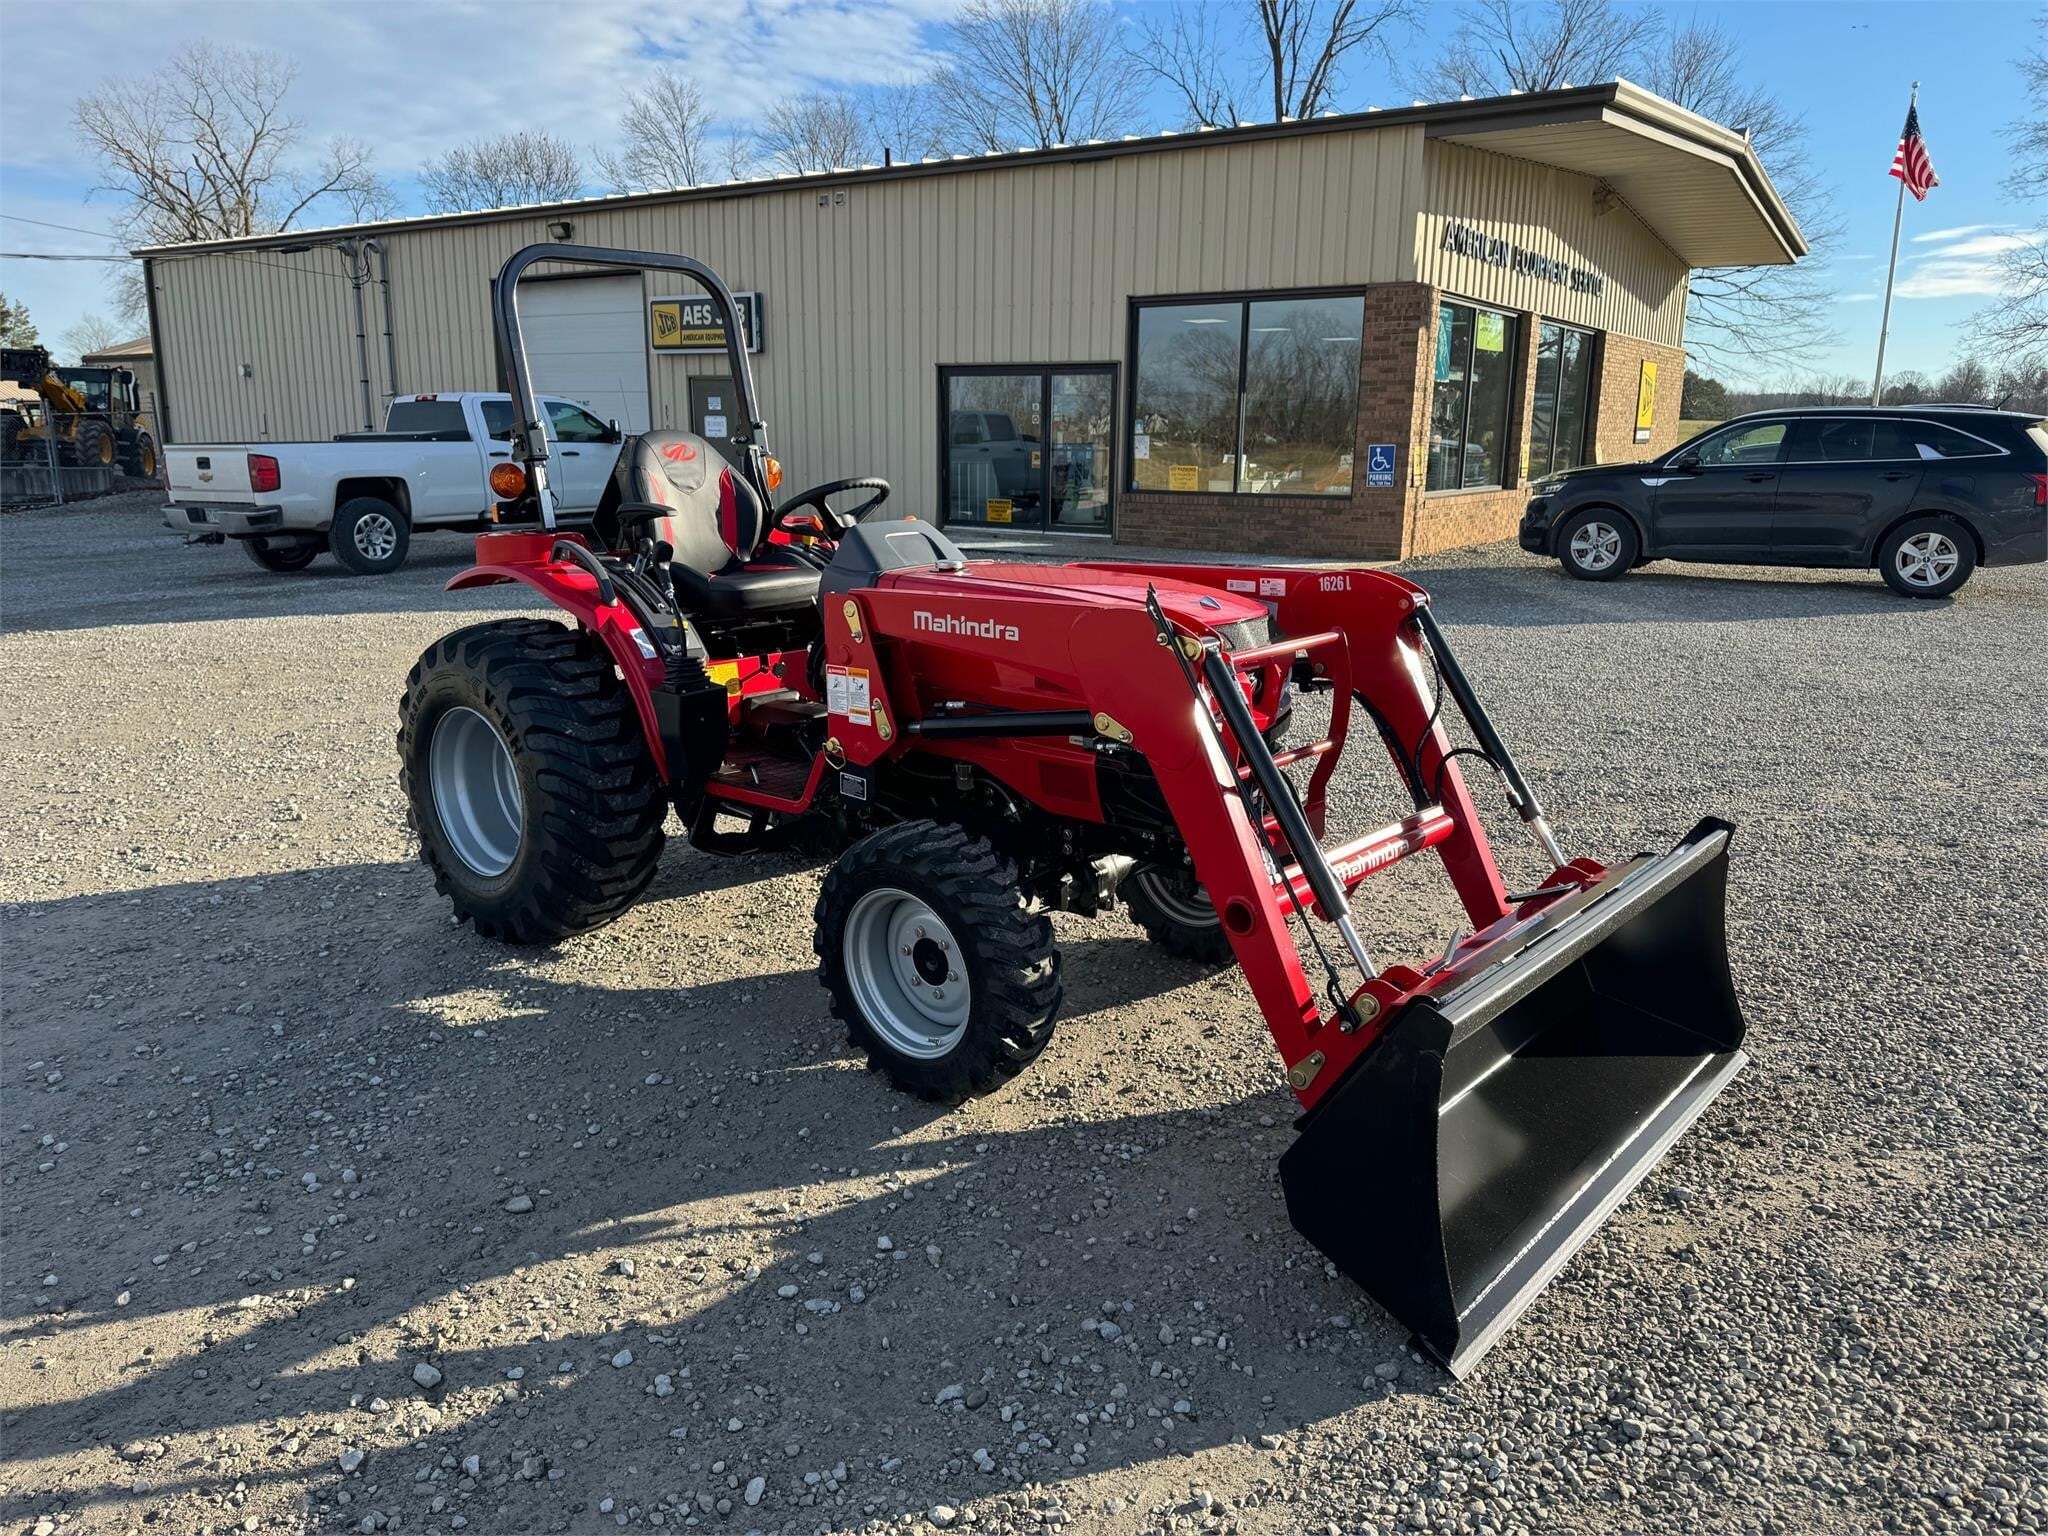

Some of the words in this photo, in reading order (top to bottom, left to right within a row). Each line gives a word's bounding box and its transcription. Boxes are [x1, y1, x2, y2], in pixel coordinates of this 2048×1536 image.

[1442, 218, 1509, 268] AMERICAN
[1512, 244, 1570, 287] EQUIPMENT
[657, 312, 678, 335] JCB
[682, 305, 712, 326] AES
[1369, 473, 1392, 481] PARKING
[1318, 575, 1344, 592] 1626
[1345, 575, 1352, 592] L
[913, 610, 1020, 642] Mahindra
